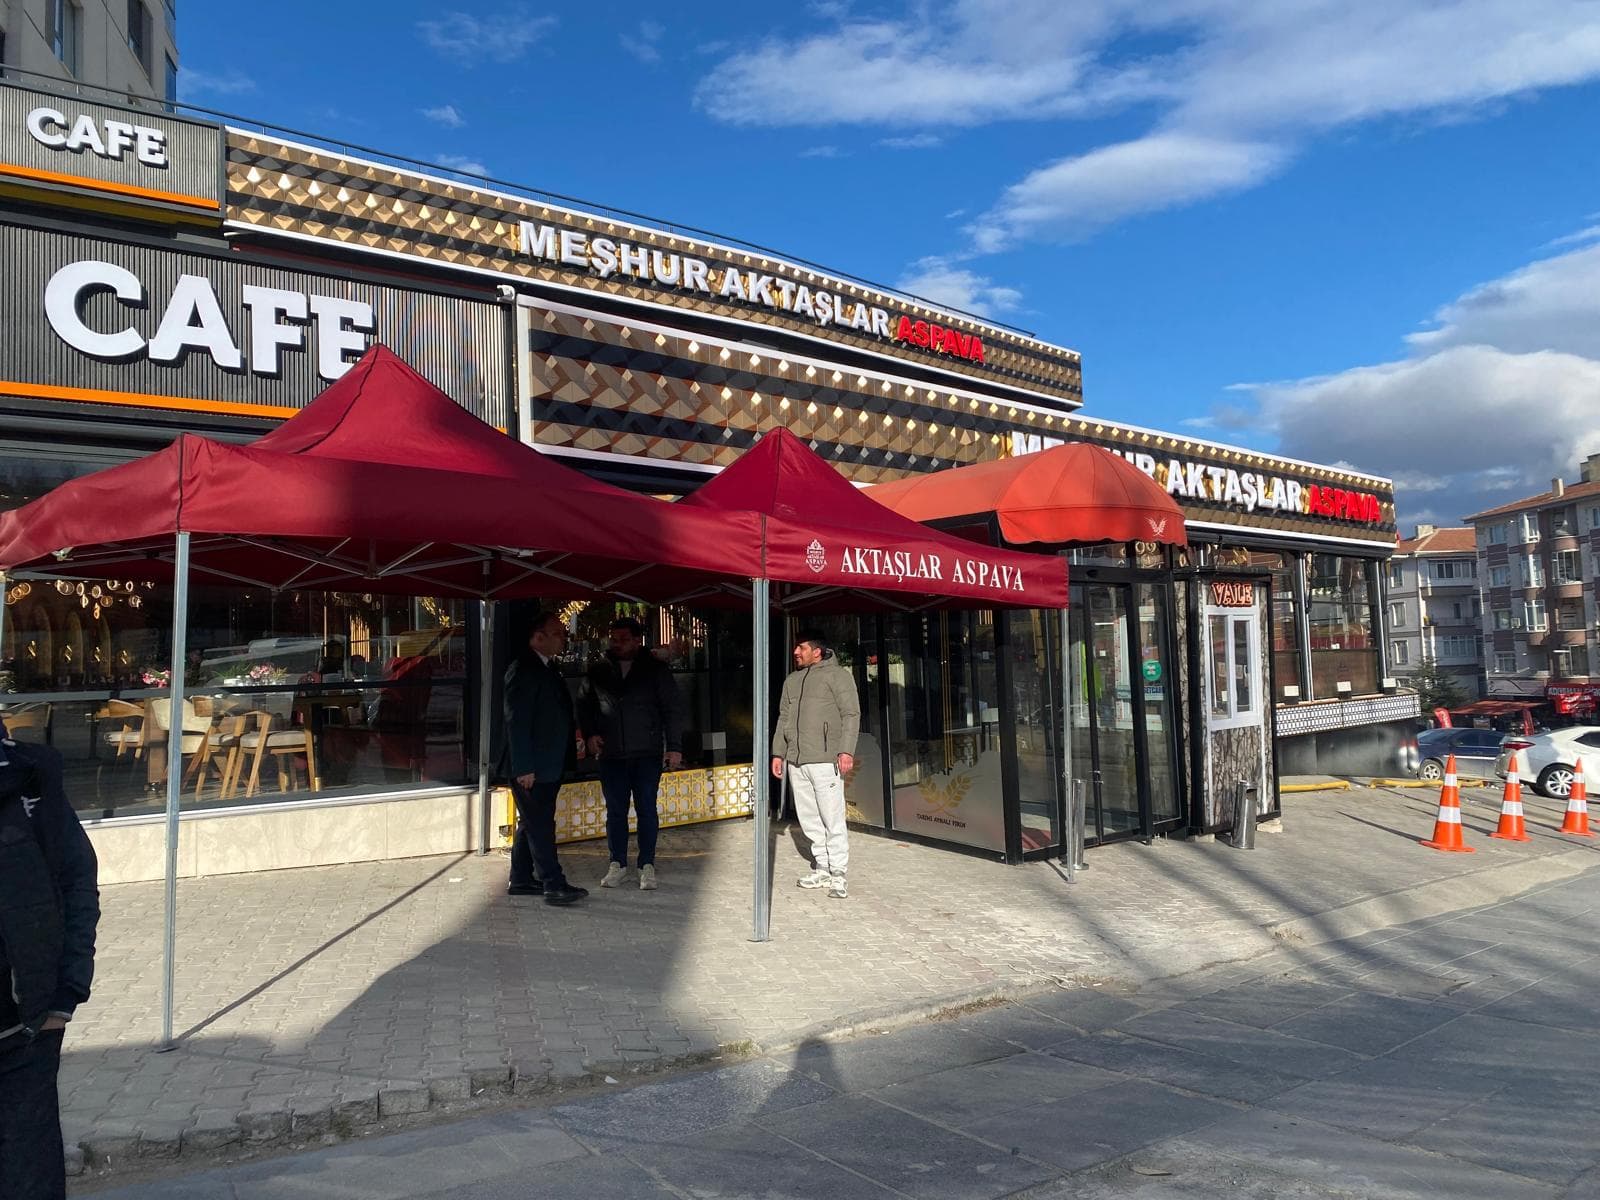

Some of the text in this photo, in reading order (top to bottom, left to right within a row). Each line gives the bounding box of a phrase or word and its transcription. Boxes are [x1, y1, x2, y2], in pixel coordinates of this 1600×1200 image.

[27, 107, 168, 166] CAFE
[44, 260, 374, 381] CAFE
[519, 220, 984, 362] MEŞHUR AKTAŞLAR ASPAVA
[1166, 459, 1381, 523] AKTAŞLAR ASPAVA
[841, 546, 1025, 592] AKTAŞLAR ASPAVA
[1211, 582, 1253, 607] VALE
